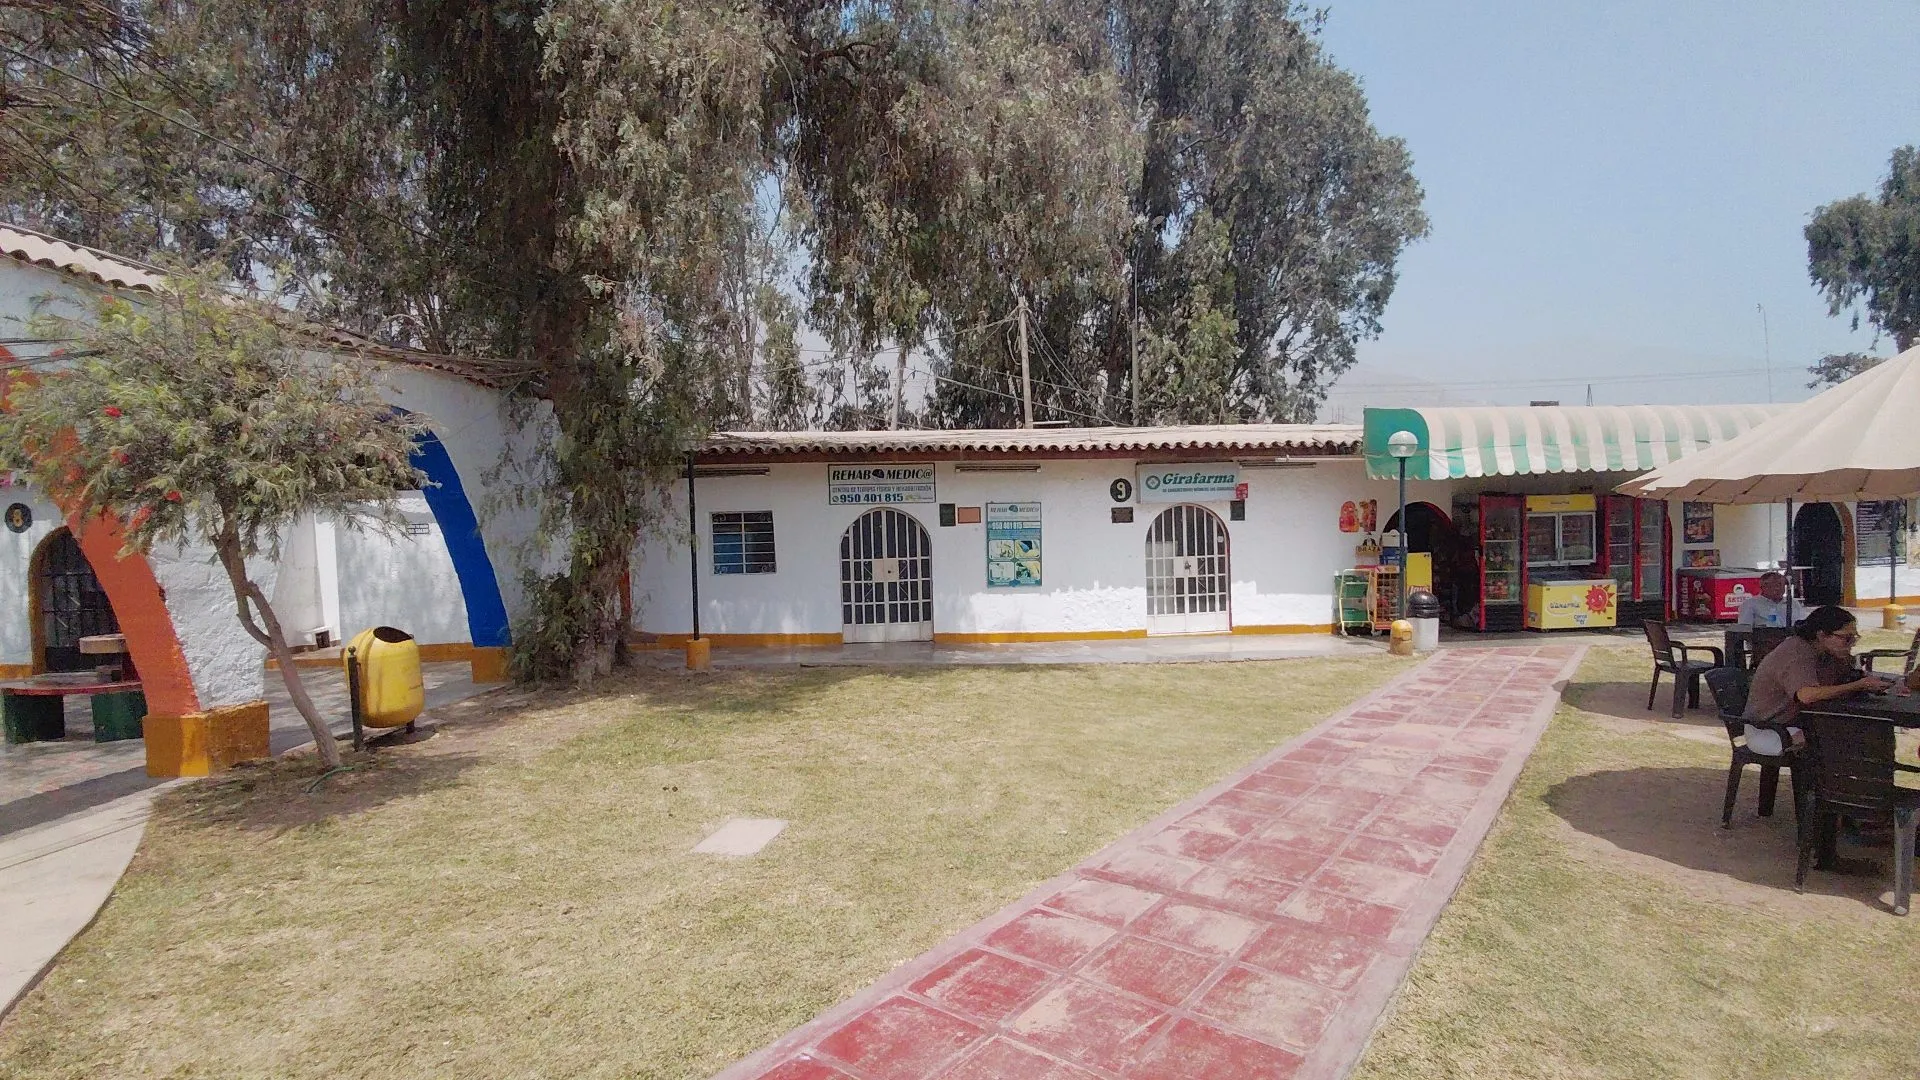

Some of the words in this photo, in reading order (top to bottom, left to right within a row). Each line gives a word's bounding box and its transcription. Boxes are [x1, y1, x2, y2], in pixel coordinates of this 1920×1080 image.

[832, 469, 872, 480] REHAB
[886, 468, 933, 480] MEDIC@
[1162, 472, 1235, 485] Girafarma
[1116, 482, 1126, 499] 9
[840, 493, 860, 503] 950
[863, 493, 882, 502] 401
[884, 493, 904, 502] 815
[12, 508, 24, 528] 8
